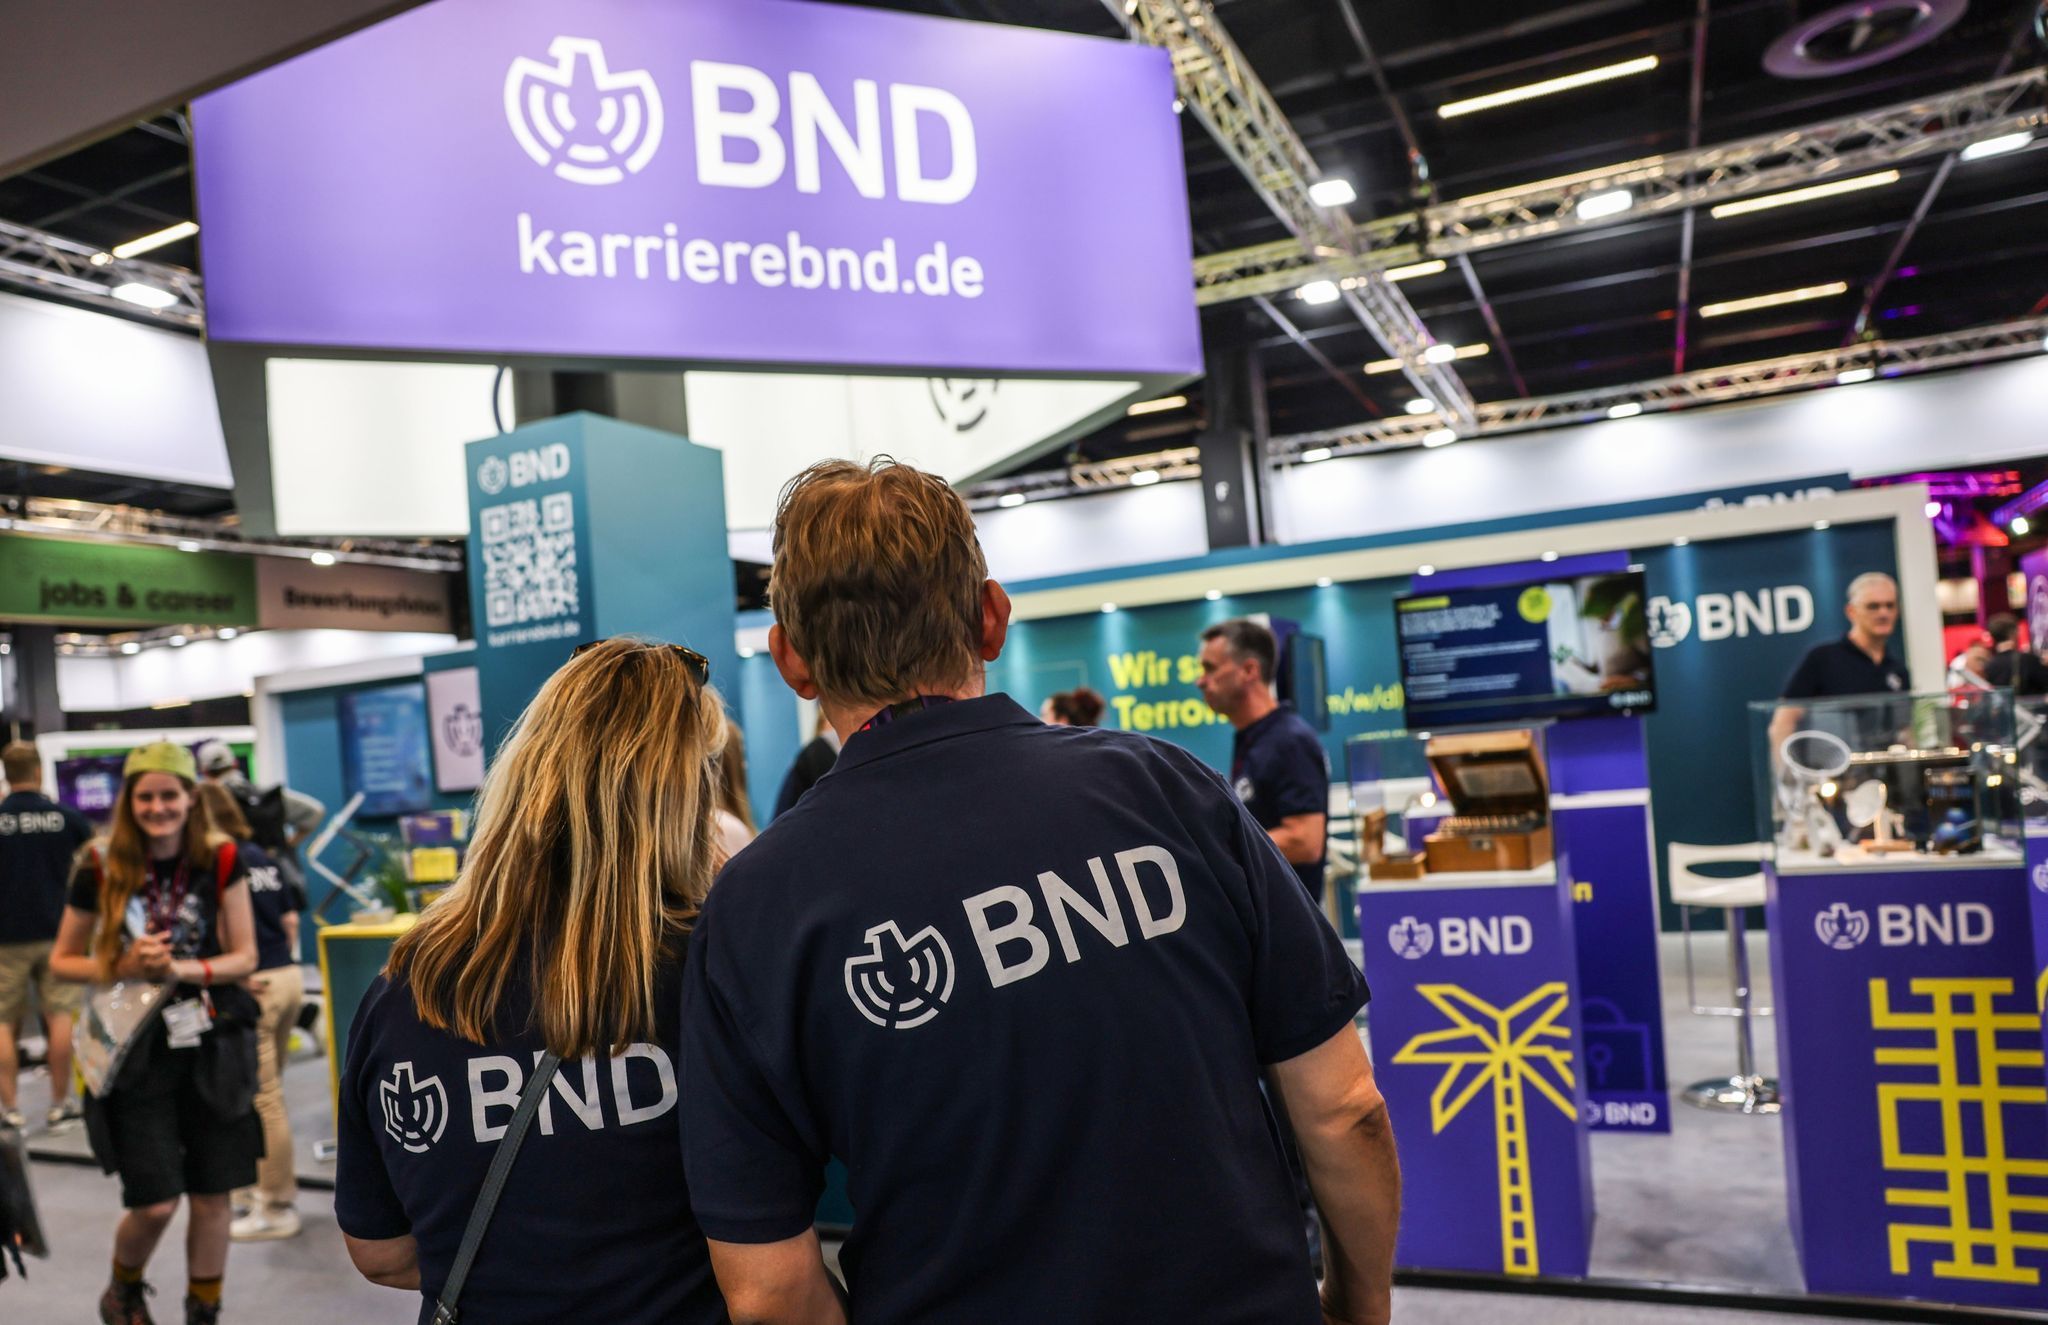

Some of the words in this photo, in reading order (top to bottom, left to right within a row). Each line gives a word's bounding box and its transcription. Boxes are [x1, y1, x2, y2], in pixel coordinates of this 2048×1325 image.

[690, 60, 978, 205] BND
[516, 213, 985, 300] karrierebnd.de
[508, 443, 571, 488] BND
[38, 578, 108, 611] jobs
[116, 583, 138, 610] &
[1695, 585, 1814, 641] BND
[1108, 650, 1171, 690] Wir
[19, 811, 65, 834] BND
[962, 845, 1186, 988] BND
[1439, 916, 1533, 956] BND
[1878, 902, 1994, 946] BND
[467, 1042, 678, 1143] BND
[1604, 1101, 1656, 1126] BND
